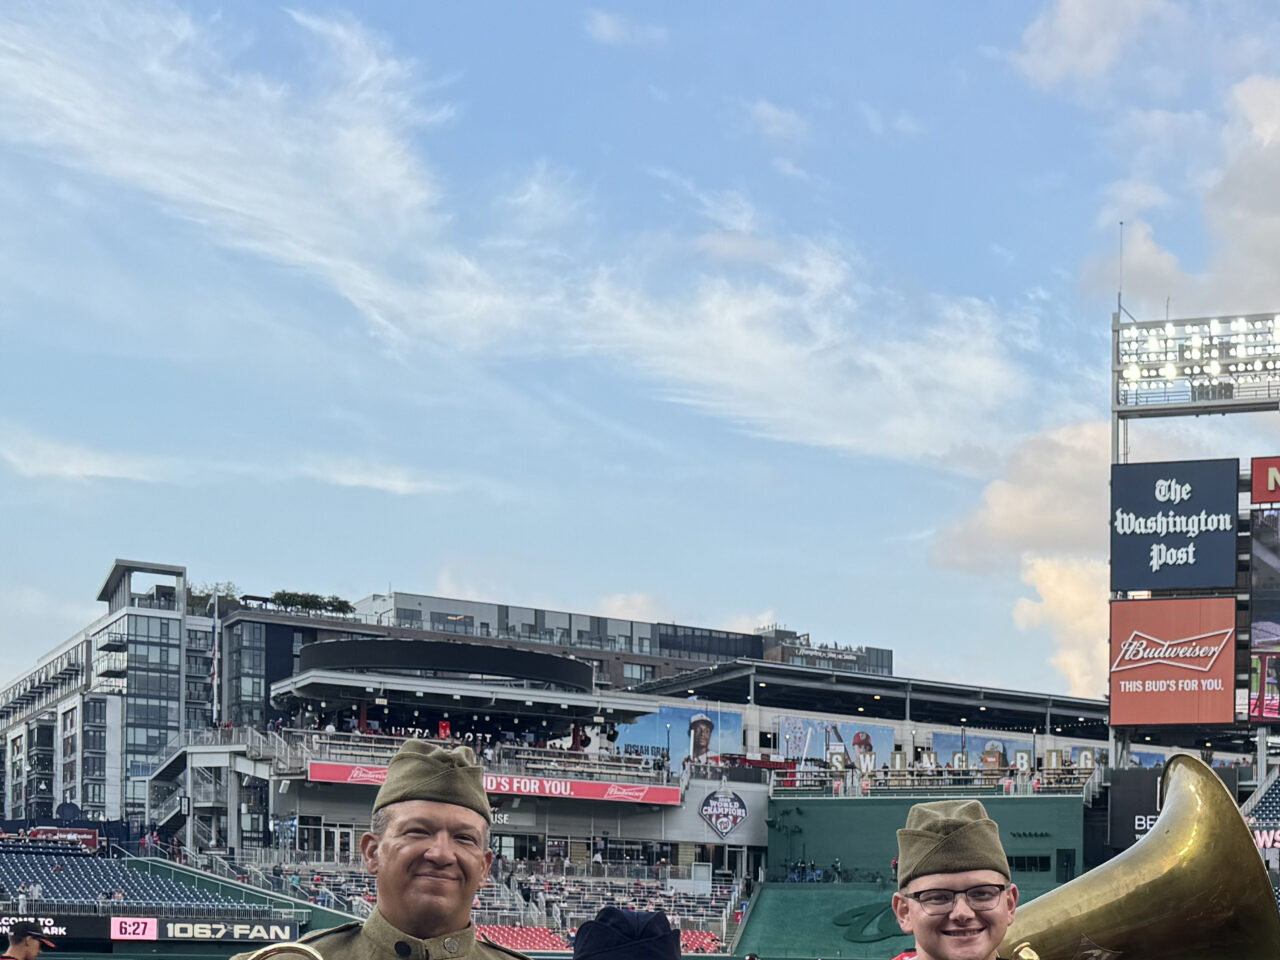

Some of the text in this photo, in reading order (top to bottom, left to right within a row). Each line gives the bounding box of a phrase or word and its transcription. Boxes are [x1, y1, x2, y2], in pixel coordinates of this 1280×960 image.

[1154, 478, 1193, 504] The
[1114, 508, 1233, 537] Washington
[1149, 542, 1197, 572] Post
[1120, 639, 1220, 661] Budweiser
[1119, 679, 1224, 692] THIS BUD'S FOR YOU.
[513, 778, 541, 793] FOR
[543, 779, 574, 796] YOU.
[702, 805, 746, 817] CHAMPIONS
[709, 799, 739, 808] WORLD
[37, 916, 54, 926] TO
[119, 920, 148, 936] 6:27
[42, 926, 67, 936] ARK
[166, 922, 226, 939] 106.7
[232, 922, 291, 940] FAN
